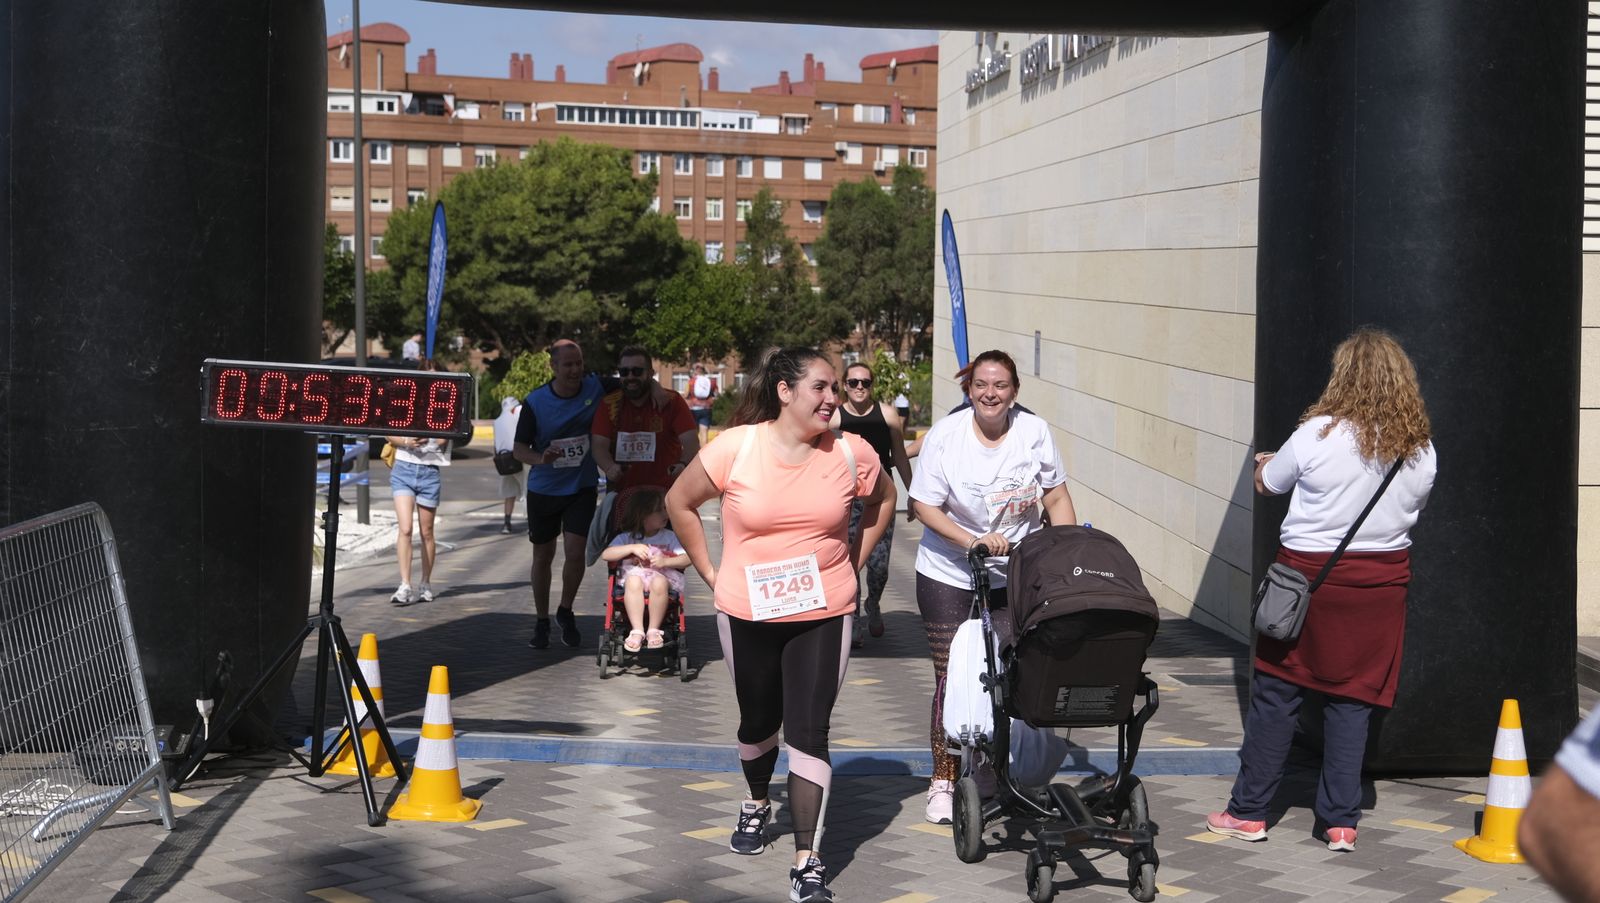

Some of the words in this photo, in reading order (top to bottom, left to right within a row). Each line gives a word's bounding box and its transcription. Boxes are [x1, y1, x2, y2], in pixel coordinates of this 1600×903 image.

[216, 369, 457, 430] 00:53:38
[622, 441, 652, 452] 1187
[759, 574, 814, 600] 1249
